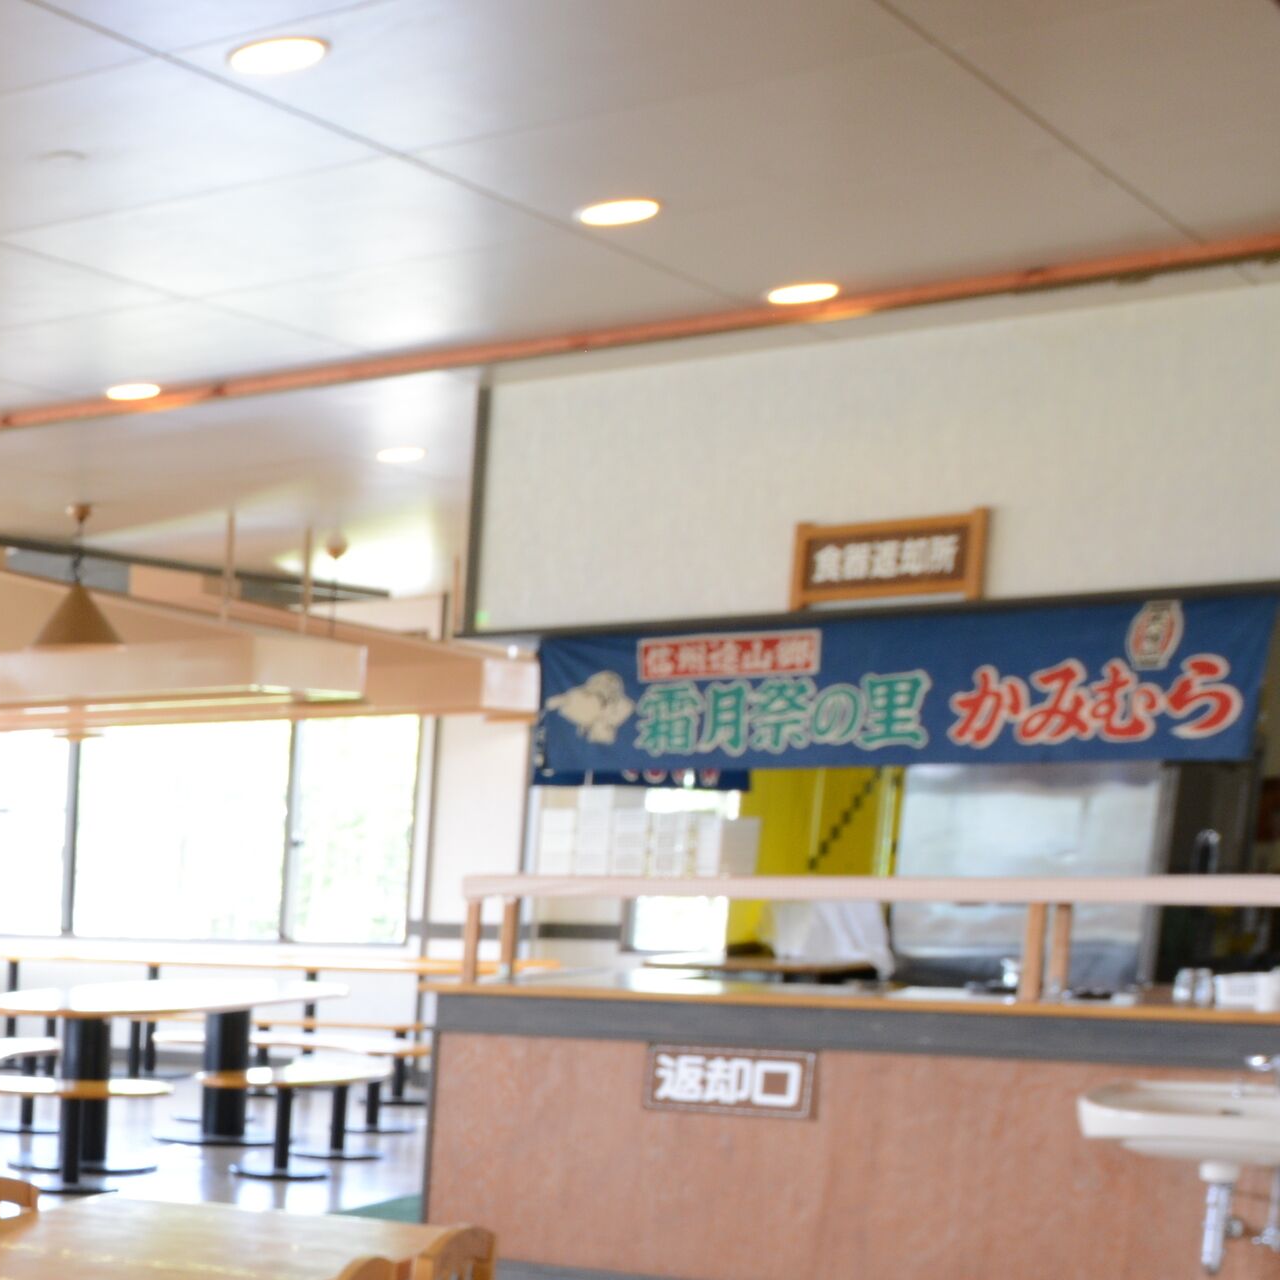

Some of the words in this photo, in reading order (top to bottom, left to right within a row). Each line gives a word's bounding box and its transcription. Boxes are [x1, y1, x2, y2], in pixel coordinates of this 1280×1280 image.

[636, 668, 932, 756] 霜月祭の里
[951, 654, 1242, 746] かみむら
[654, 1053, 803, 1109] 返却口
